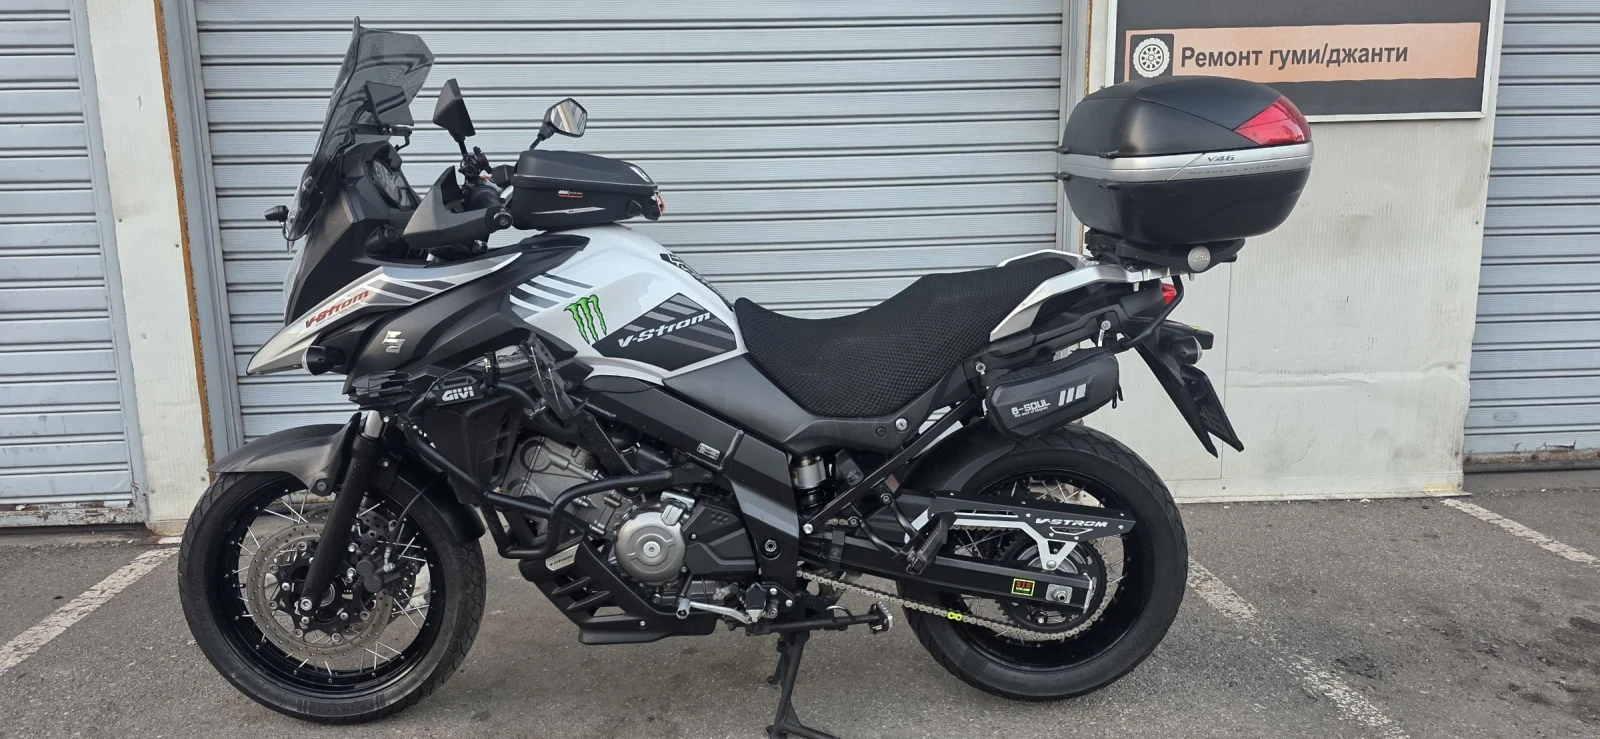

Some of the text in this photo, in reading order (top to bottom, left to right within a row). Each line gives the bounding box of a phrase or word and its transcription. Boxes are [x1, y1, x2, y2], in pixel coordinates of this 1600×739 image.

[1181, 43, 1409, 70] Ремонт гуми/джанти
[1207, 154, 1236, 162] V46
[617, 311, 711, 348] V-Strom
[441, 386, 475, 402] GIVI
[1010, 398, 1051, 415] B-SOUL
[1035, 517, 1108, 528] V-STROM
